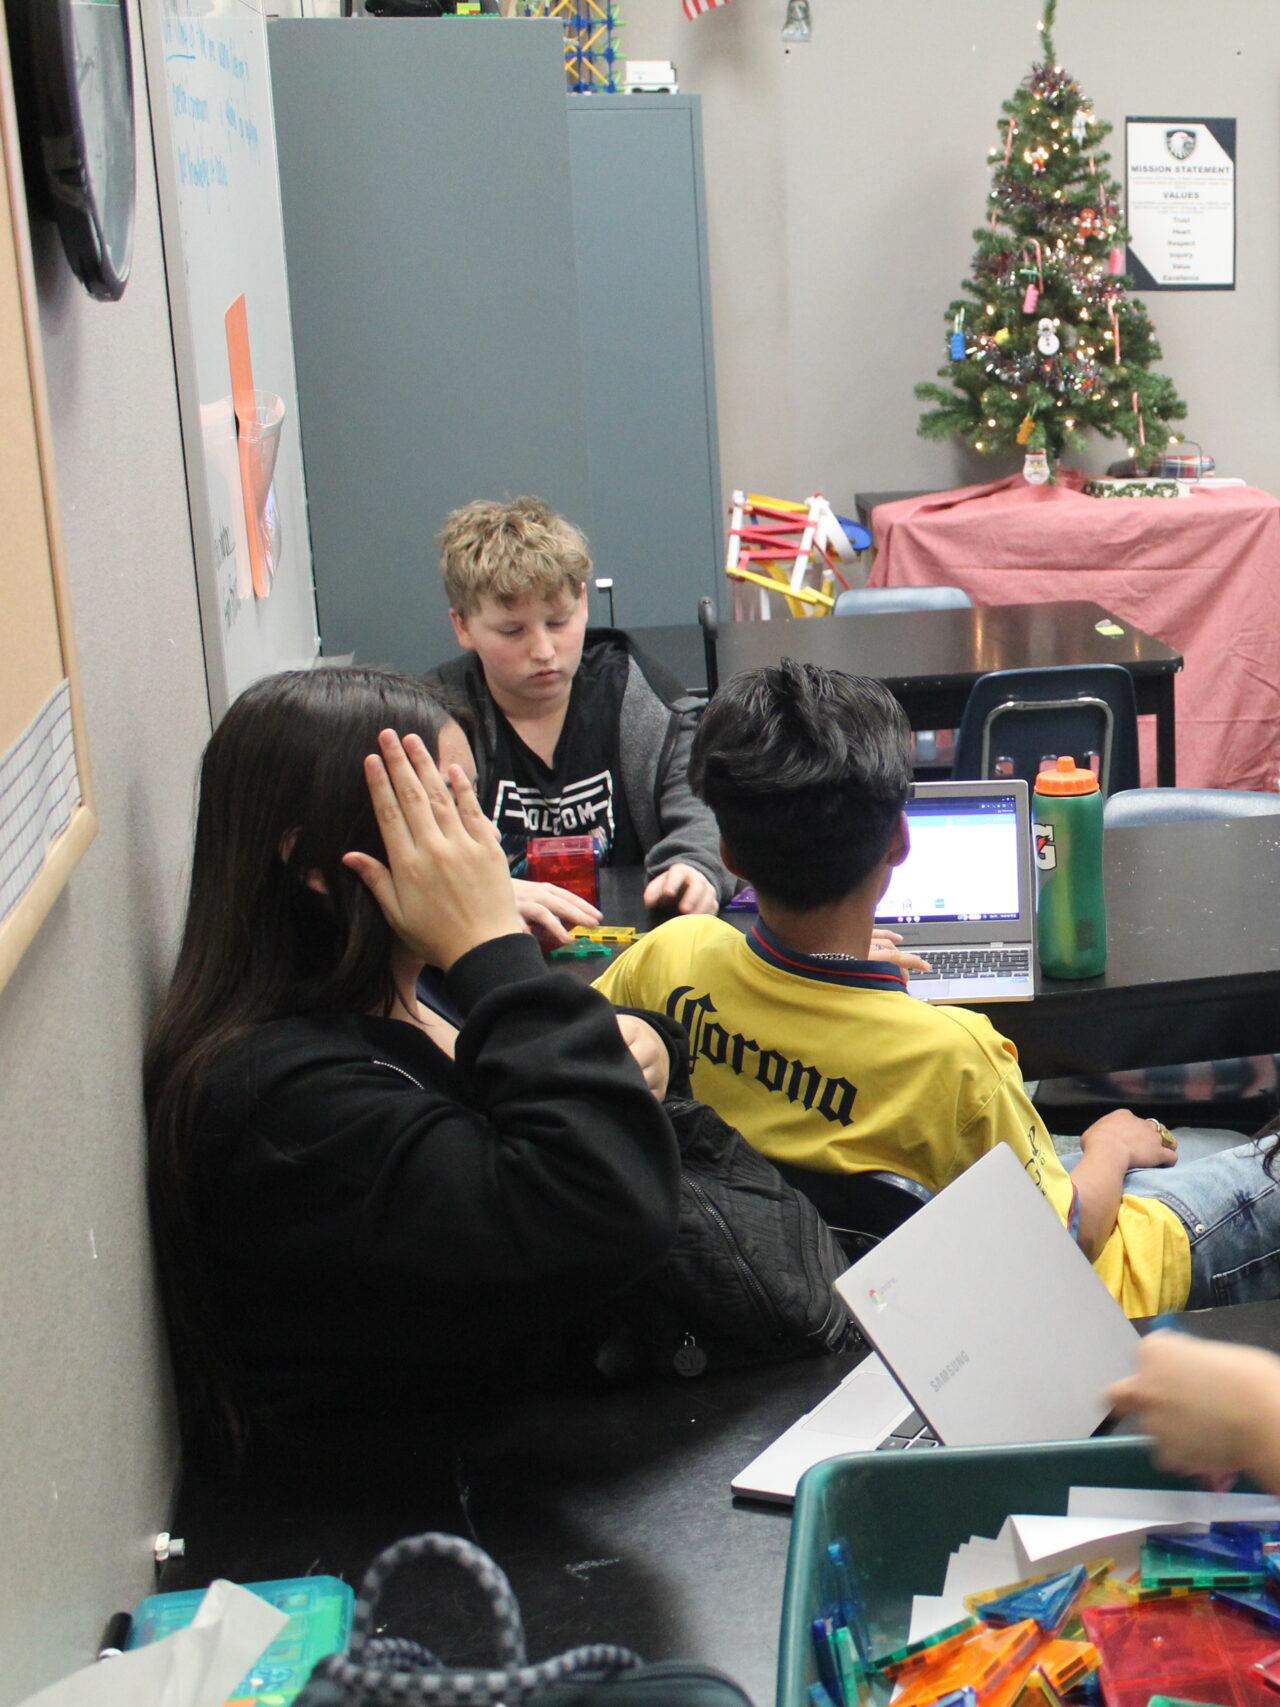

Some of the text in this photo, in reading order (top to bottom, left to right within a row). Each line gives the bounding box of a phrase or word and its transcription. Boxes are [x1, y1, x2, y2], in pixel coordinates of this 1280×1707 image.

[1131, 165, 1231, 174] MISSION STATEMENT
[1163, 191, 1200, 199] VALUES
[667, 985, 858, 1127] Corona
[929, 1350, 970, 1393] SAMSUNG
